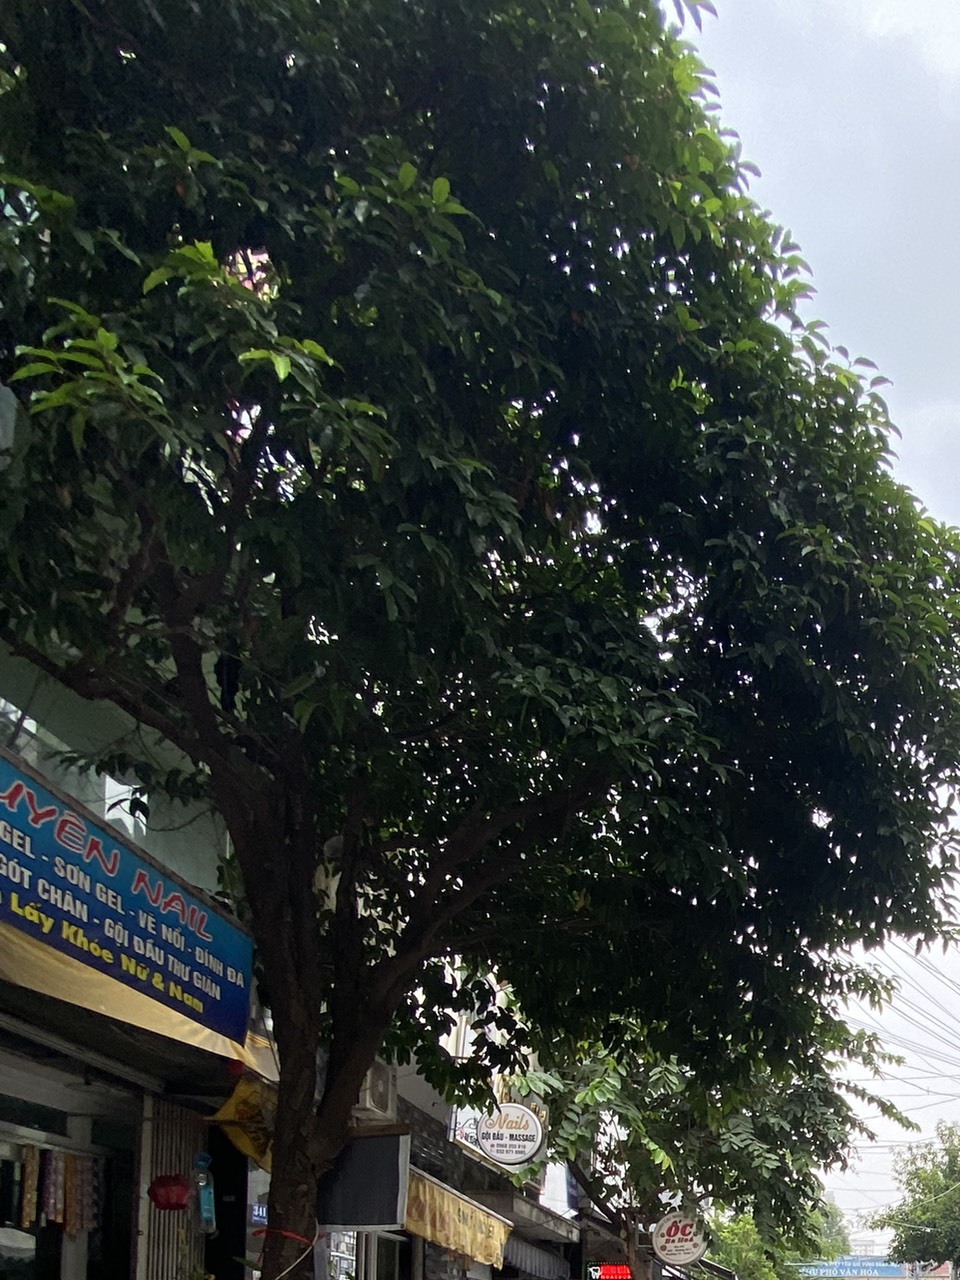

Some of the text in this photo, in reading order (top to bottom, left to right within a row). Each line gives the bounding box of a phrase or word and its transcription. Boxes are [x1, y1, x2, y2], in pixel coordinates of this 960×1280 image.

[37, 878, 89, 923] CHÂN
[104, 917, 129, 948] GỘI
[133, 935, 164, 966] ĐẦU
[167, 954, 191, 982] THƯ
[192, 971, 221, 1001] GIÃN
[54, 856, 91, 894] SƠN
[95, 882, 126, 915] GEL
[139, 909, 157, 935] VẼ
[194, 946, 224, 977] ĐÍNH
[226, 966, 245, 988] ĐÁ
[131, 869, 213, 941] NAIL
[10, 891, 55, 934] Lấy
[151, 972, 165, 992] &
[168, 981, 204, 1014] Nam
[485, 1113, 529, 1131] Nails
[509, 1133, 536, 1143] MASSAGE
[666, 1219, 694, 1238] ỐC
